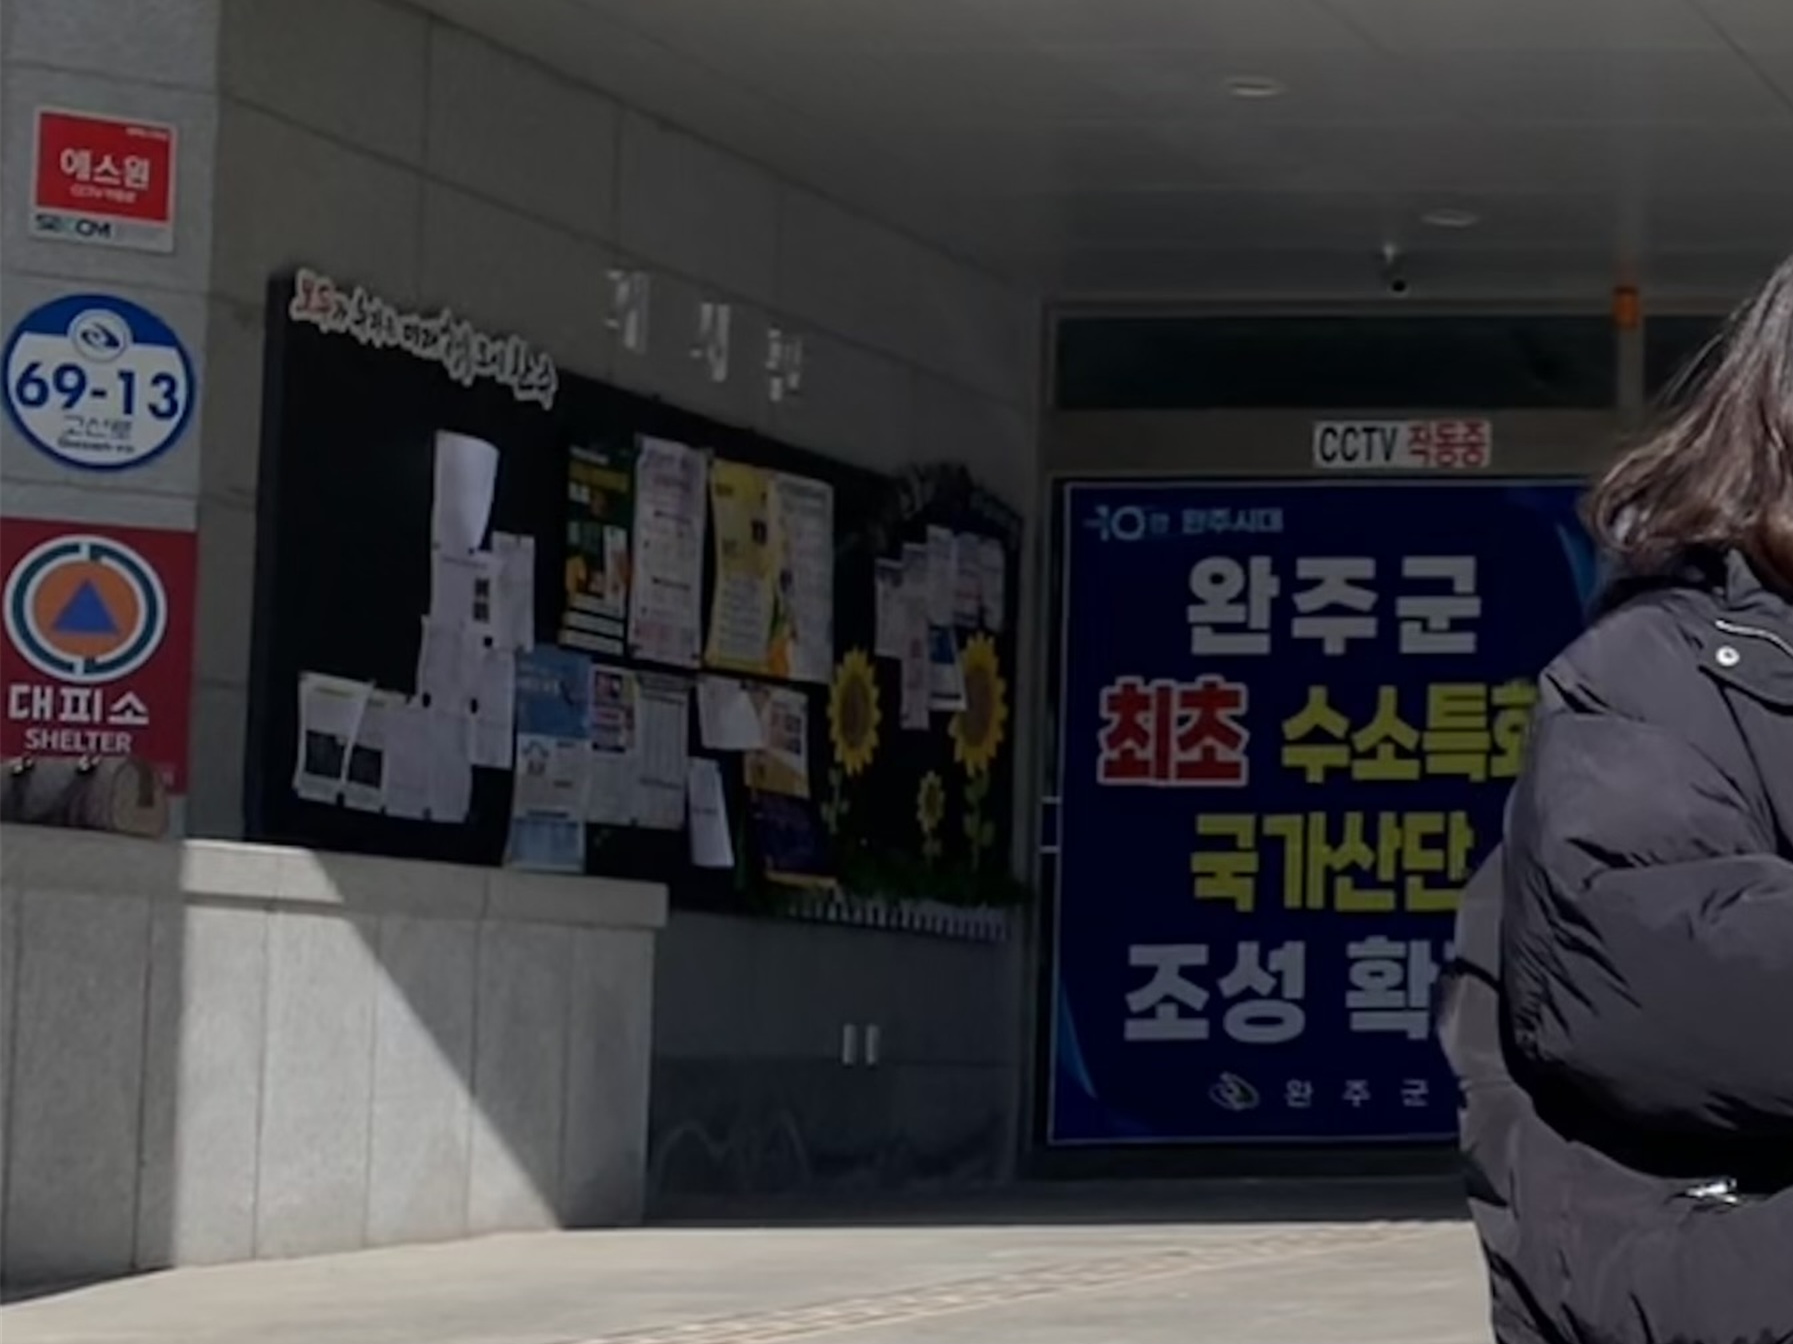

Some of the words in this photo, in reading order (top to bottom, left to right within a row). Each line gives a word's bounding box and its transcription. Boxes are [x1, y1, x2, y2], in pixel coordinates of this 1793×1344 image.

[60, 148, 151, 190] 에스원
[16, 361, 180, 421] 69-13
[1319, 425, 1397, 463] CCTV
[1407, 421, 1487, 466] 작동중
[1187, 555, 1482, 655] 완주군
[8, 684, 150, 725] 대피소
[1097, 674, 1250, 787] 최초
[25, 727, 132, 754] SHELTER
[1190, 811, 1475, 913] 국가산단
[1124, 941, 1306, 1044] 조성
[1345, 935, 1455, 1040] 확
